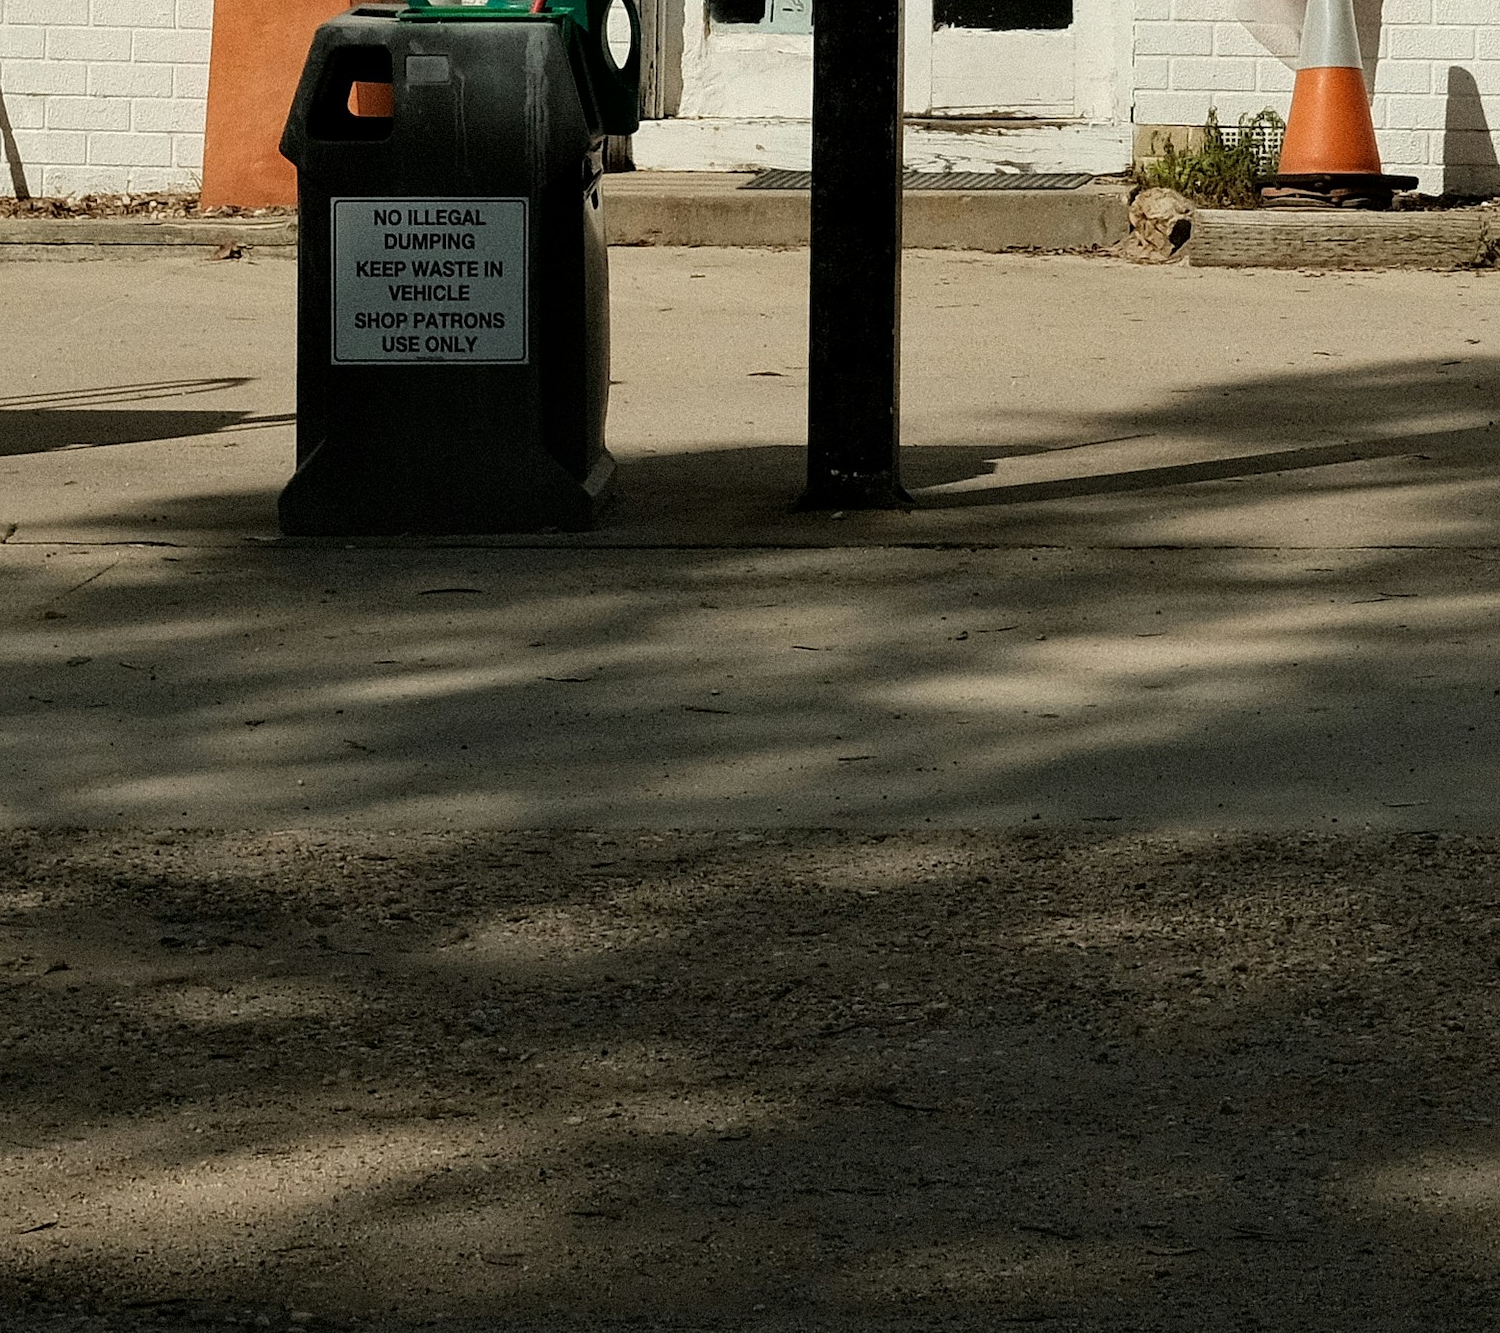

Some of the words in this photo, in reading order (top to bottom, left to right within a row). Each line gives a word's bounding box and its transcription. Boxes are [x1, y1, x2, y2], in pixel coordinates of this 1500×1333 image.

[373, 209, 402, 226] NO
[407, 209, 486, 226] ILLEGAL
[384, 233, 476, 250] DUMPING
[356, 261, 407, 277] KEEP
[411, 261, 479, 278] WASTE
[485, 261, 503, 277] IN
[388, 285, 470, 301] VEHICLE
[354, 313, 407, 329] SHOP
[413, 313, 505, 329] PATRONS
[382, 337, 420, 353] USE
[425, 337, 478, 353] ONLY
